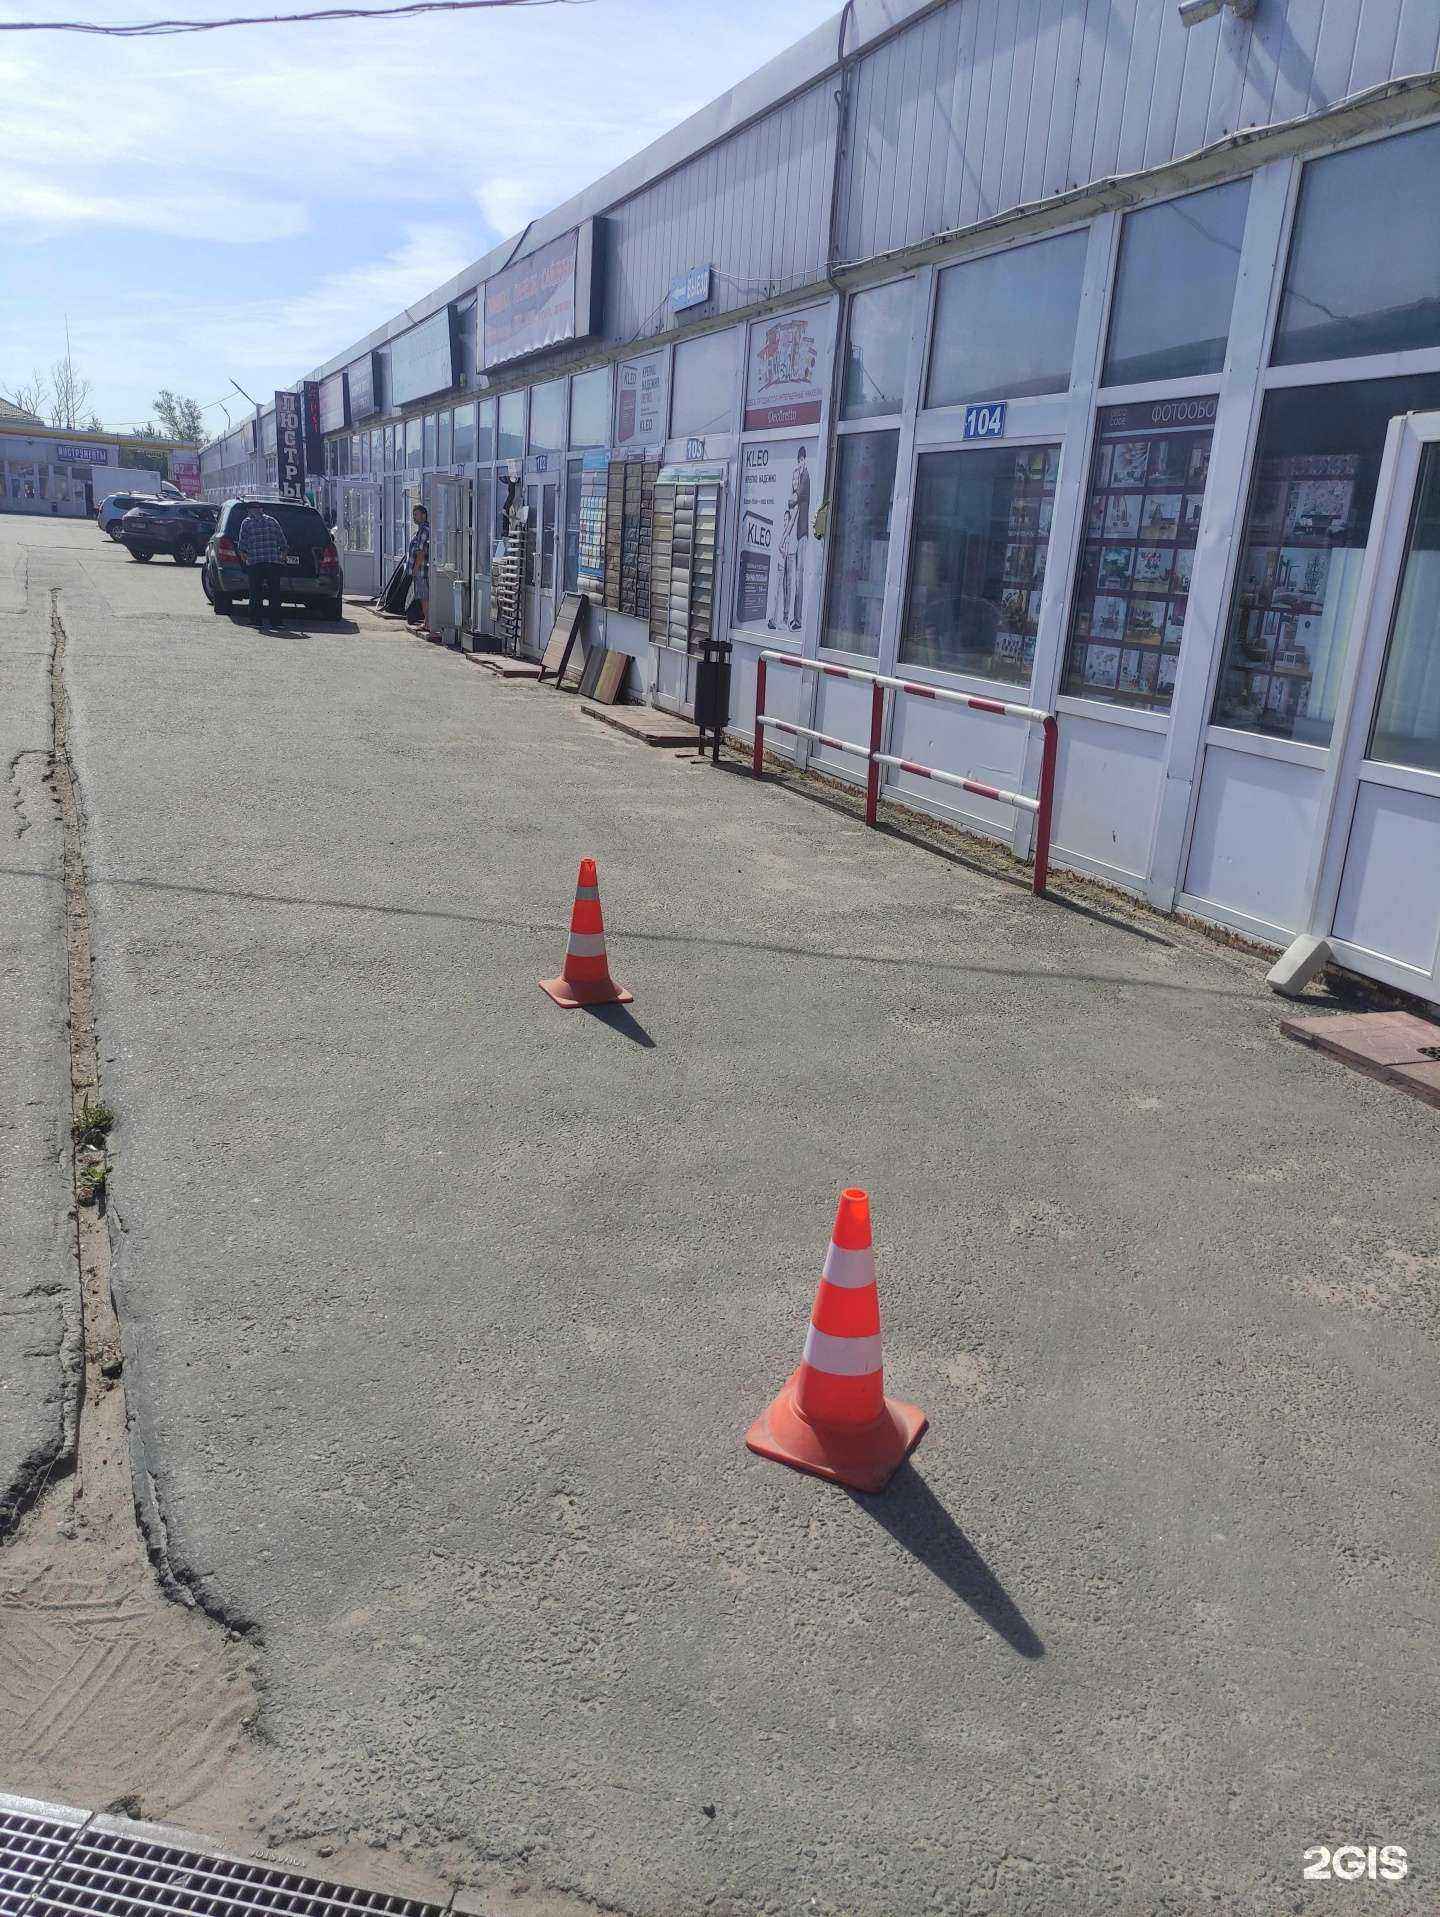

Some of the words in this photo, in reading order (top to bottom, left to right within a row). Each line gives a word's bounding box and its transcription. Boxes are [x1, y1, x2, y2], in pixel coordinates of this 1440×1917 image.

[967, 406, 1002, 436] 104
[280, 394, 302, 498] ЛЮСТРЫ
[687, 440, 702, 458] 103
[745, 449, 769, 468] KLEO
[747, 521, 772, 548] KLEO
